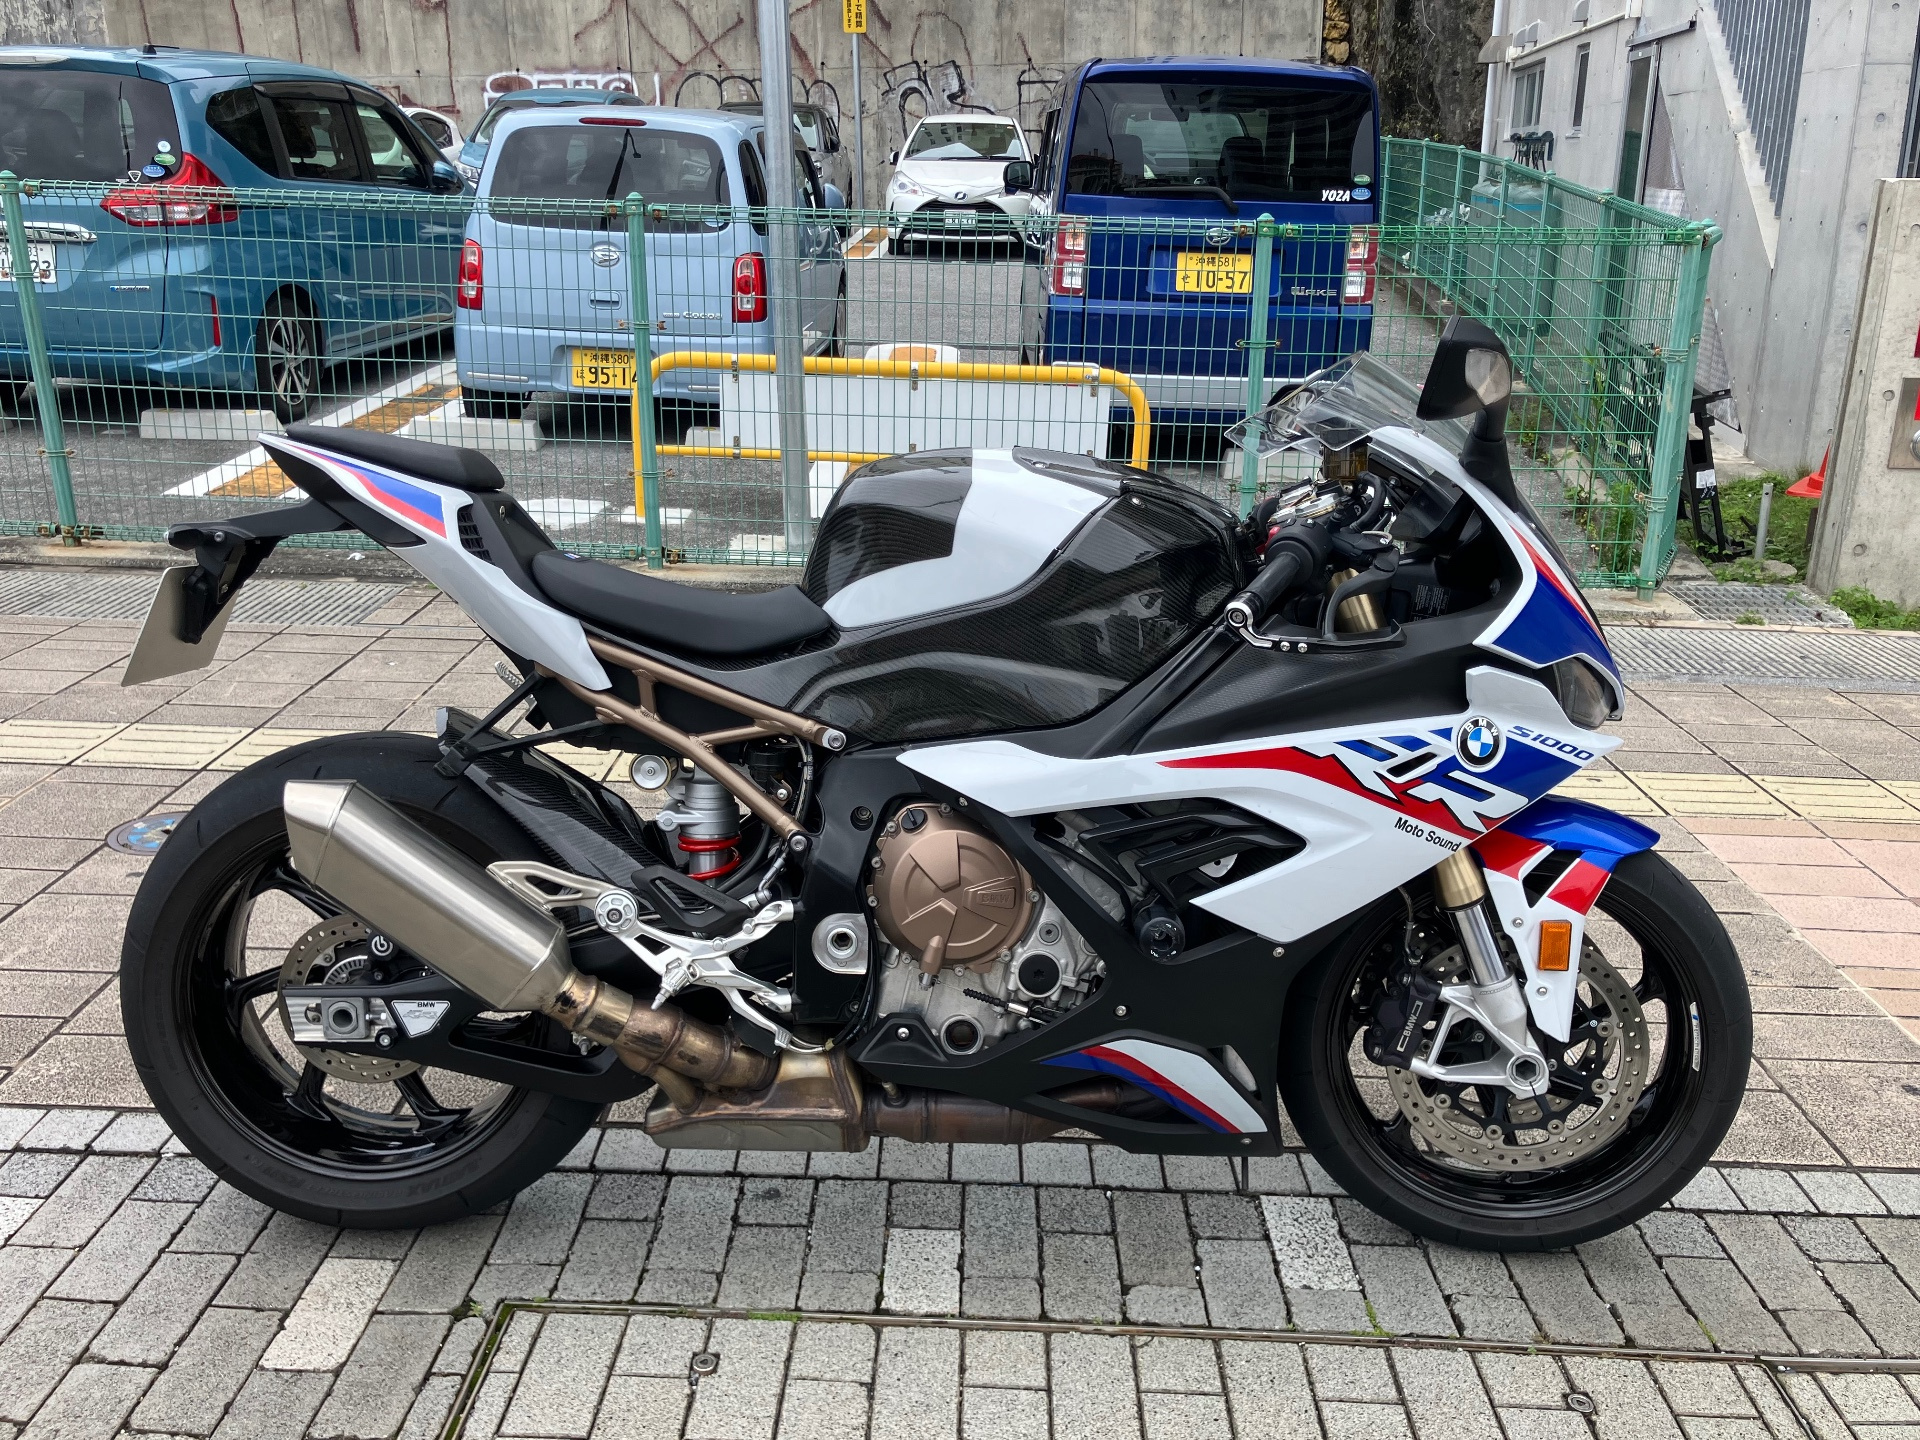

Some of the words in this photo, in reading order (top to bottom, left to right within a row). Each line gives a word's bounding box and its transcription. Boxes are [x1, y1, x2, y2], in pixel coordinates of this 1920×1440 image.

[1321, 189, 1350, 202] YOZA
[1195, 270, 1249, 290] 10-57
[1463, 715, 1500, 738] BMW
[1506, 724, 1596, 762] S1000
[1393, 816, 1424, 839] Moto
[1425, 830, 1462, 853] Sound
[1403, 1013, 1419, 1038] BMW
